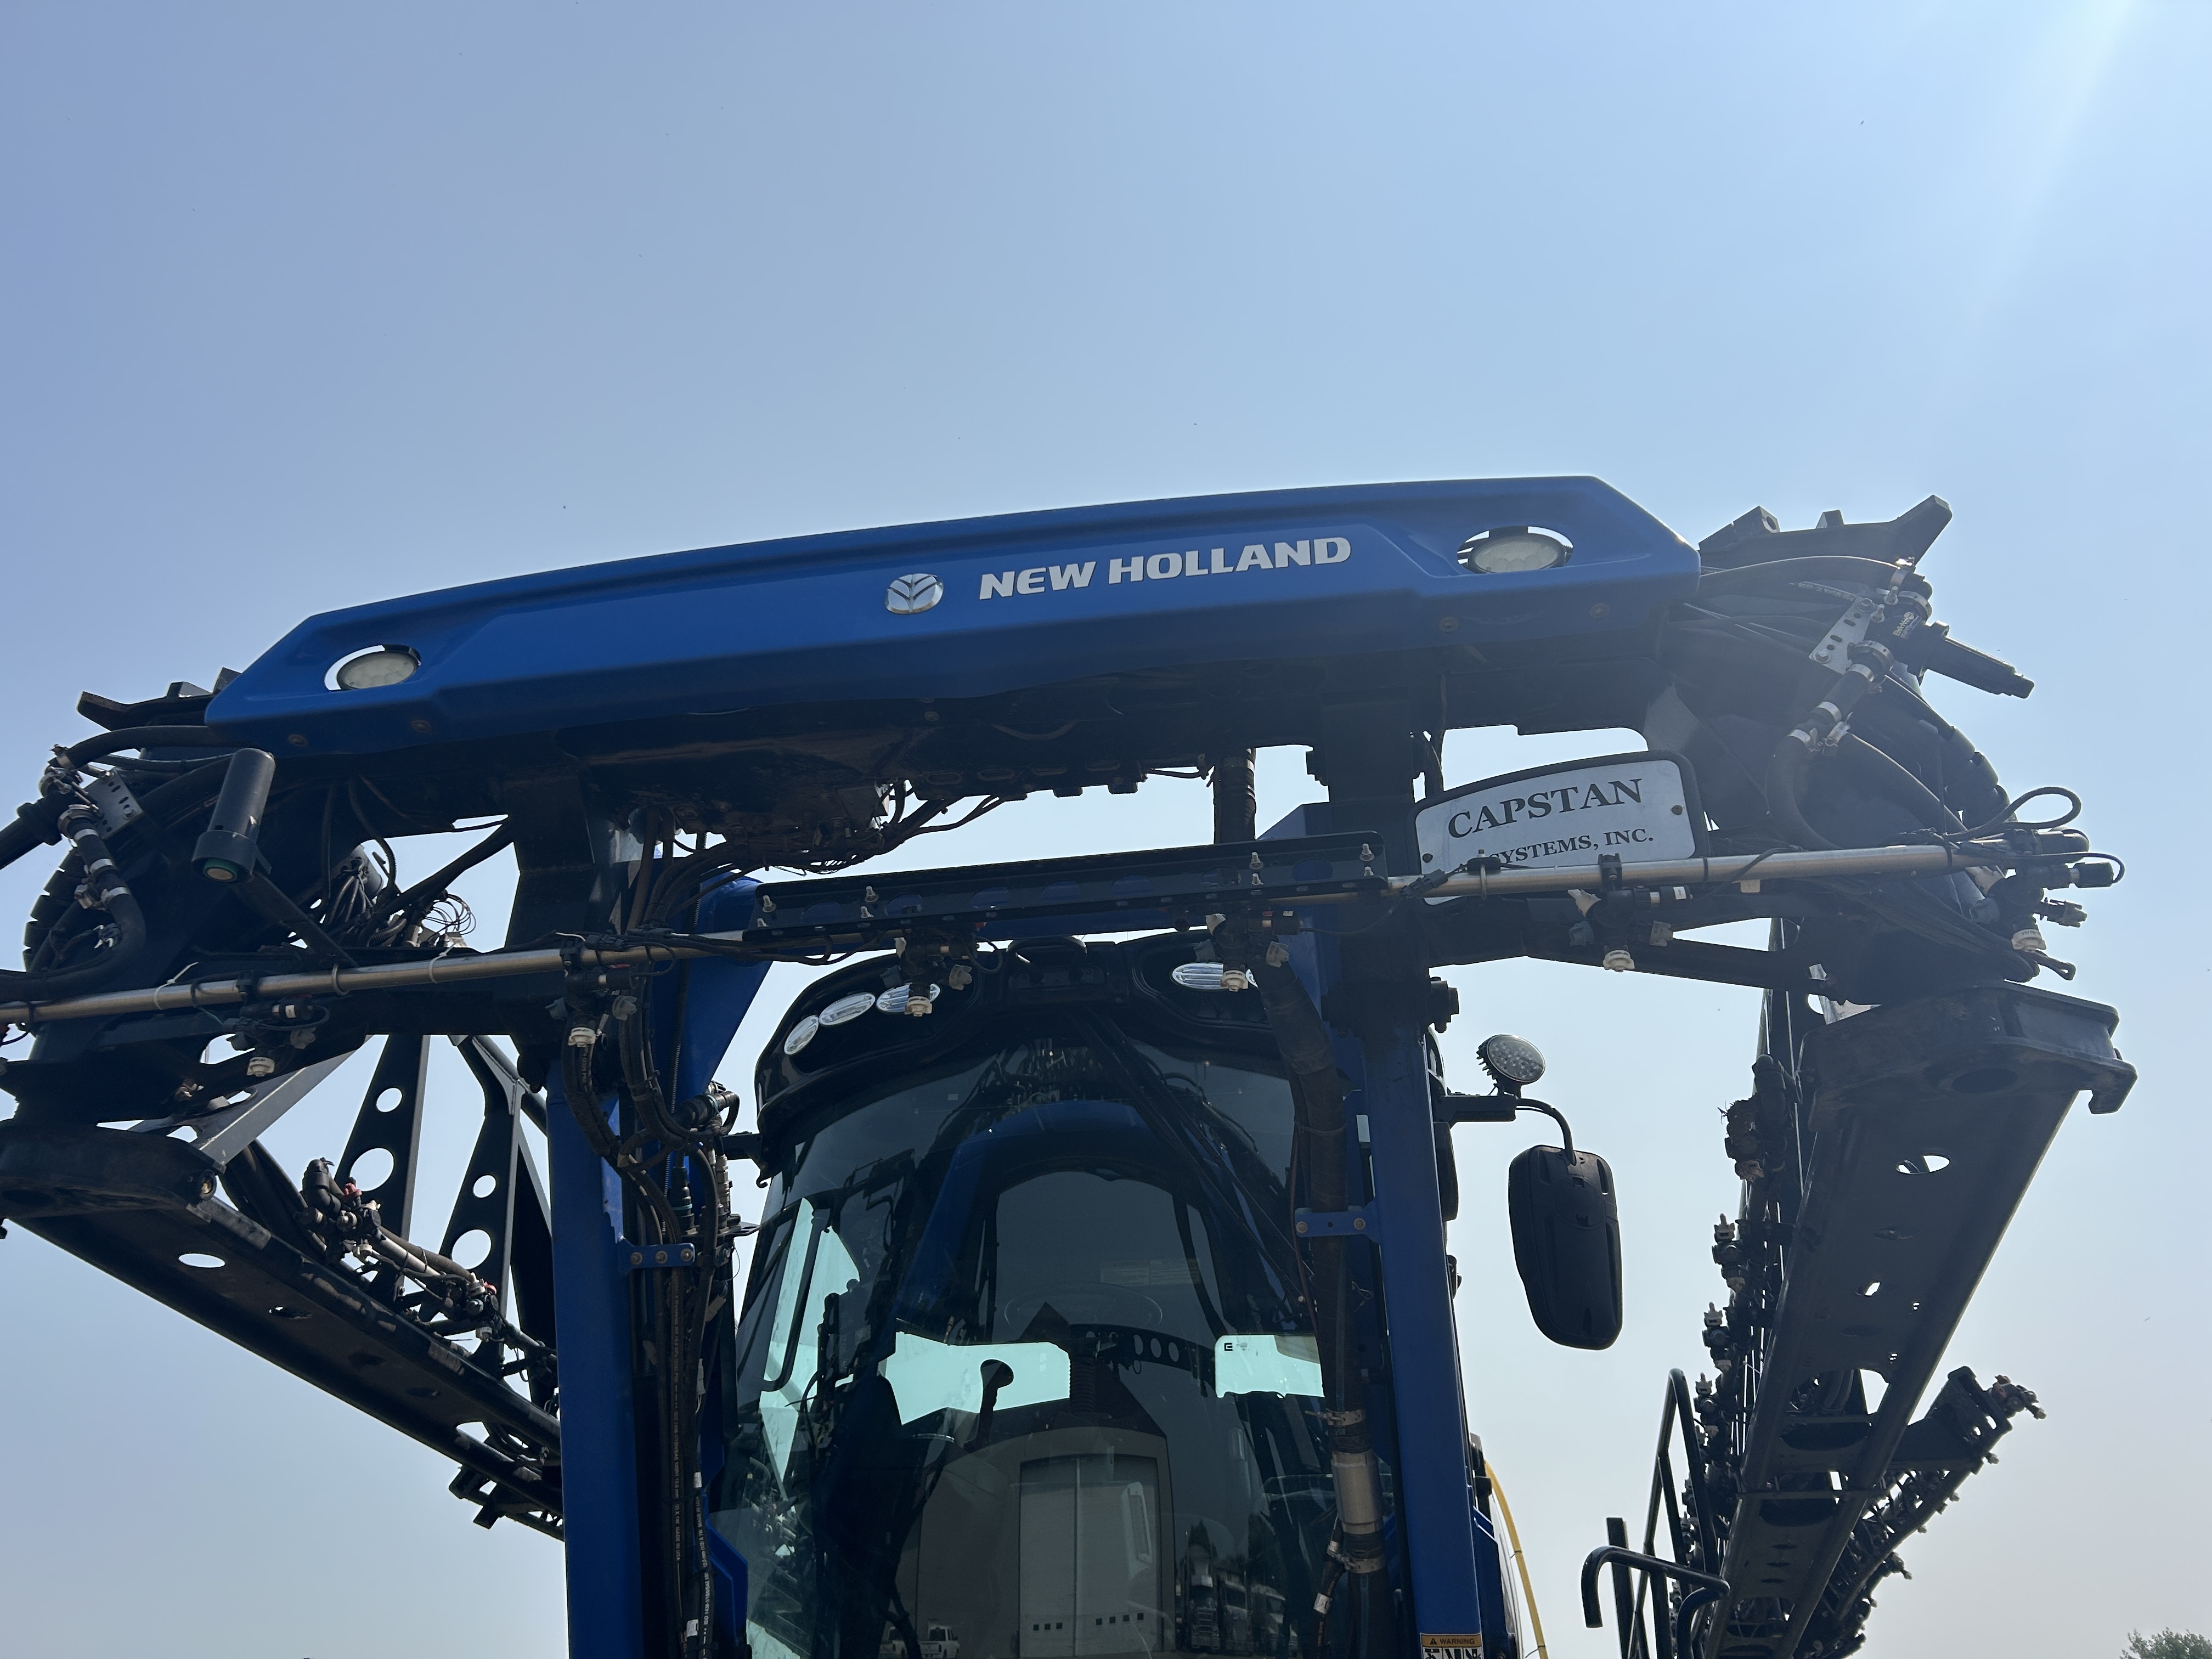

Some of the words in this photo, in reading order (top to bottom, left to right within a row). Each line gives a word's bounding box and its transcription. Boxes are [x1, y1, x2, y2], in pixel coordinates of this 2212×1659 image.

[979, 561, 1097, 600] NEW
[1108, 537, 1351, 584] HOLLAND
[1448, 778, 1643, 838] CAPSTAN
[1605, 828, 1654, 846] INC.
